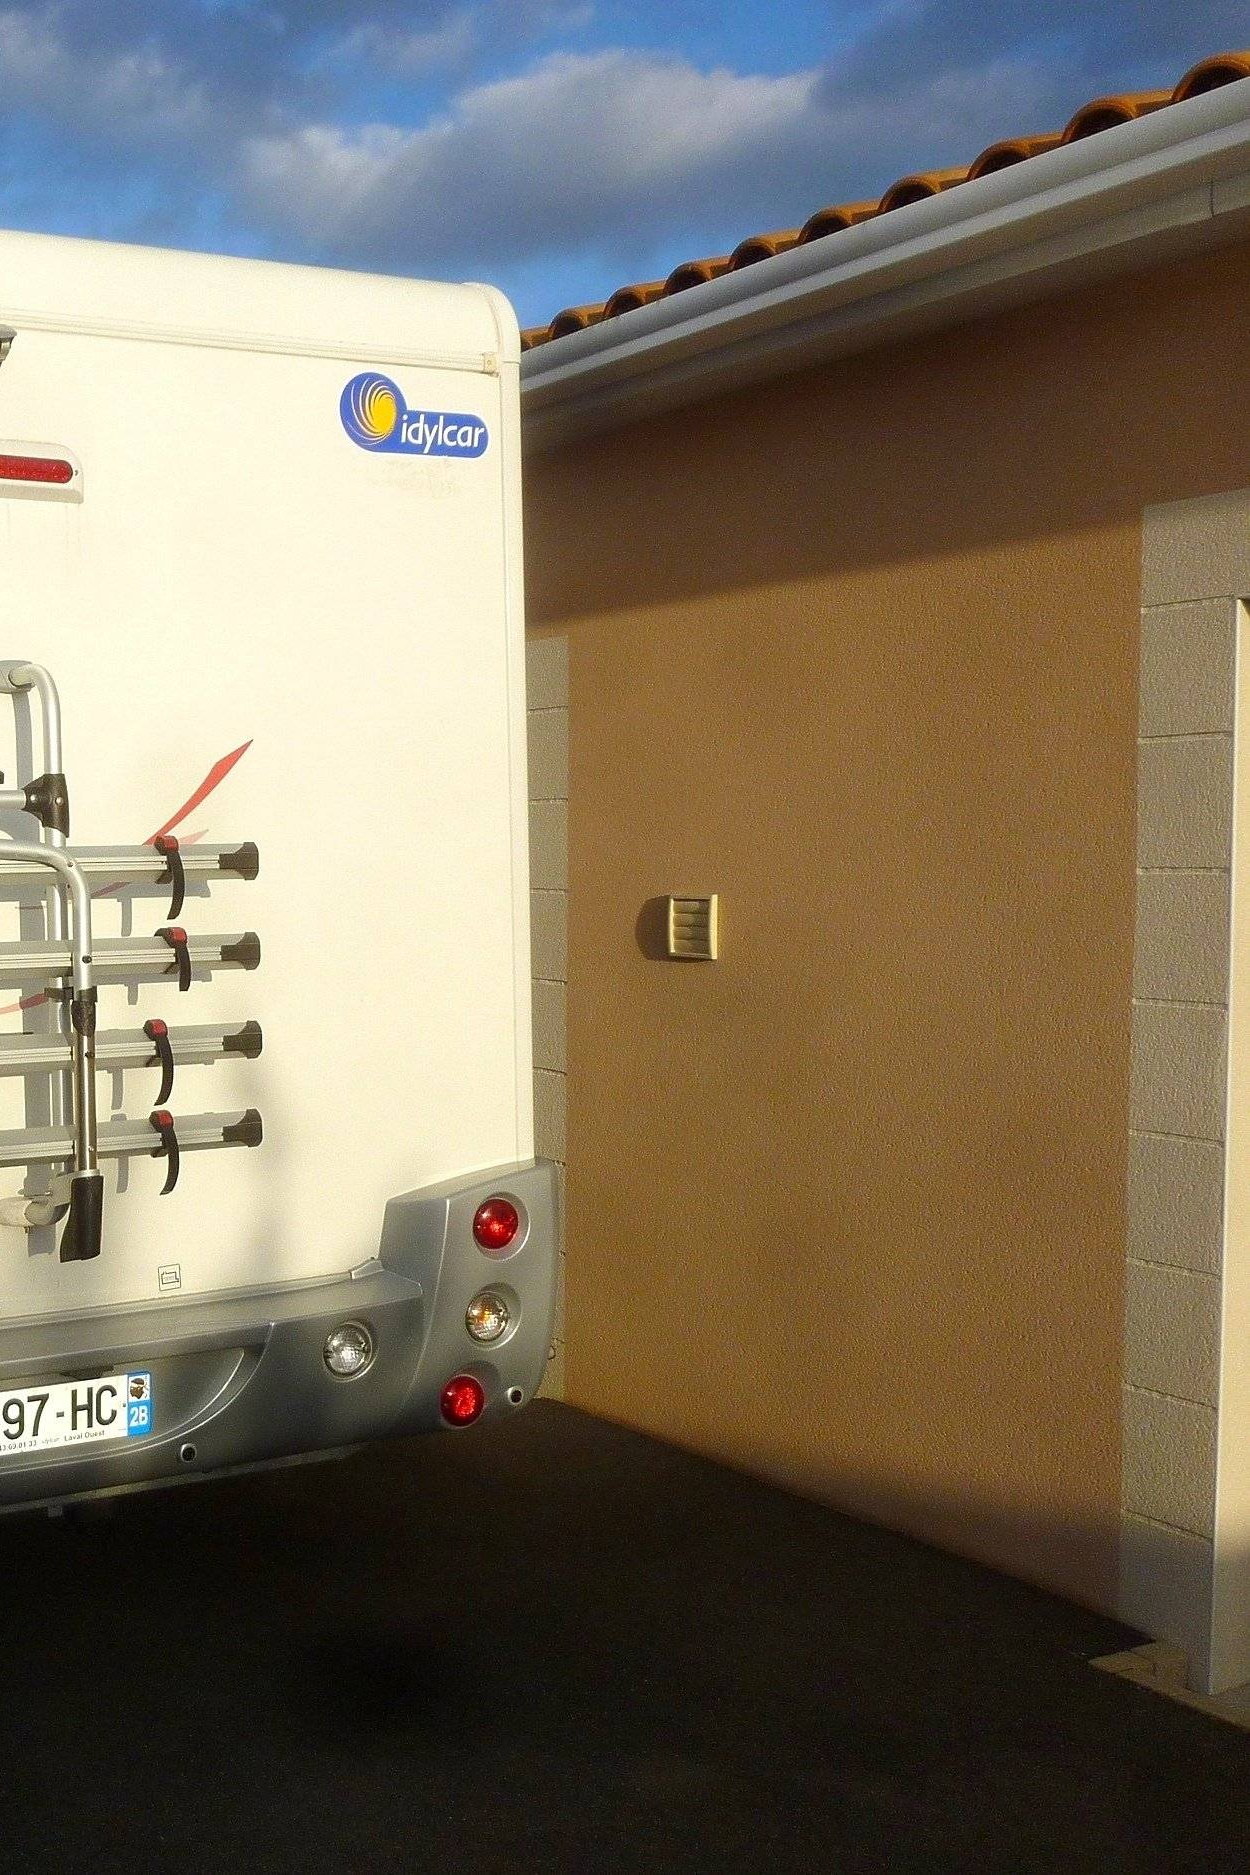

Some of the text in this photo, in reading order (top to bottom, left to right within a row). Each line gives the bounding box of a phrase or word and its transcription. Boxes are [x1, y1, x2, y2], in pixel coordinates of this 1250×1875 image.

[401, 413, 485, 454] idylcar
[130, 1405, 148, 1427] 2B
[64, 1432, 83, 1442] Laval
[84, 1430, 106, 1439] Ouest
